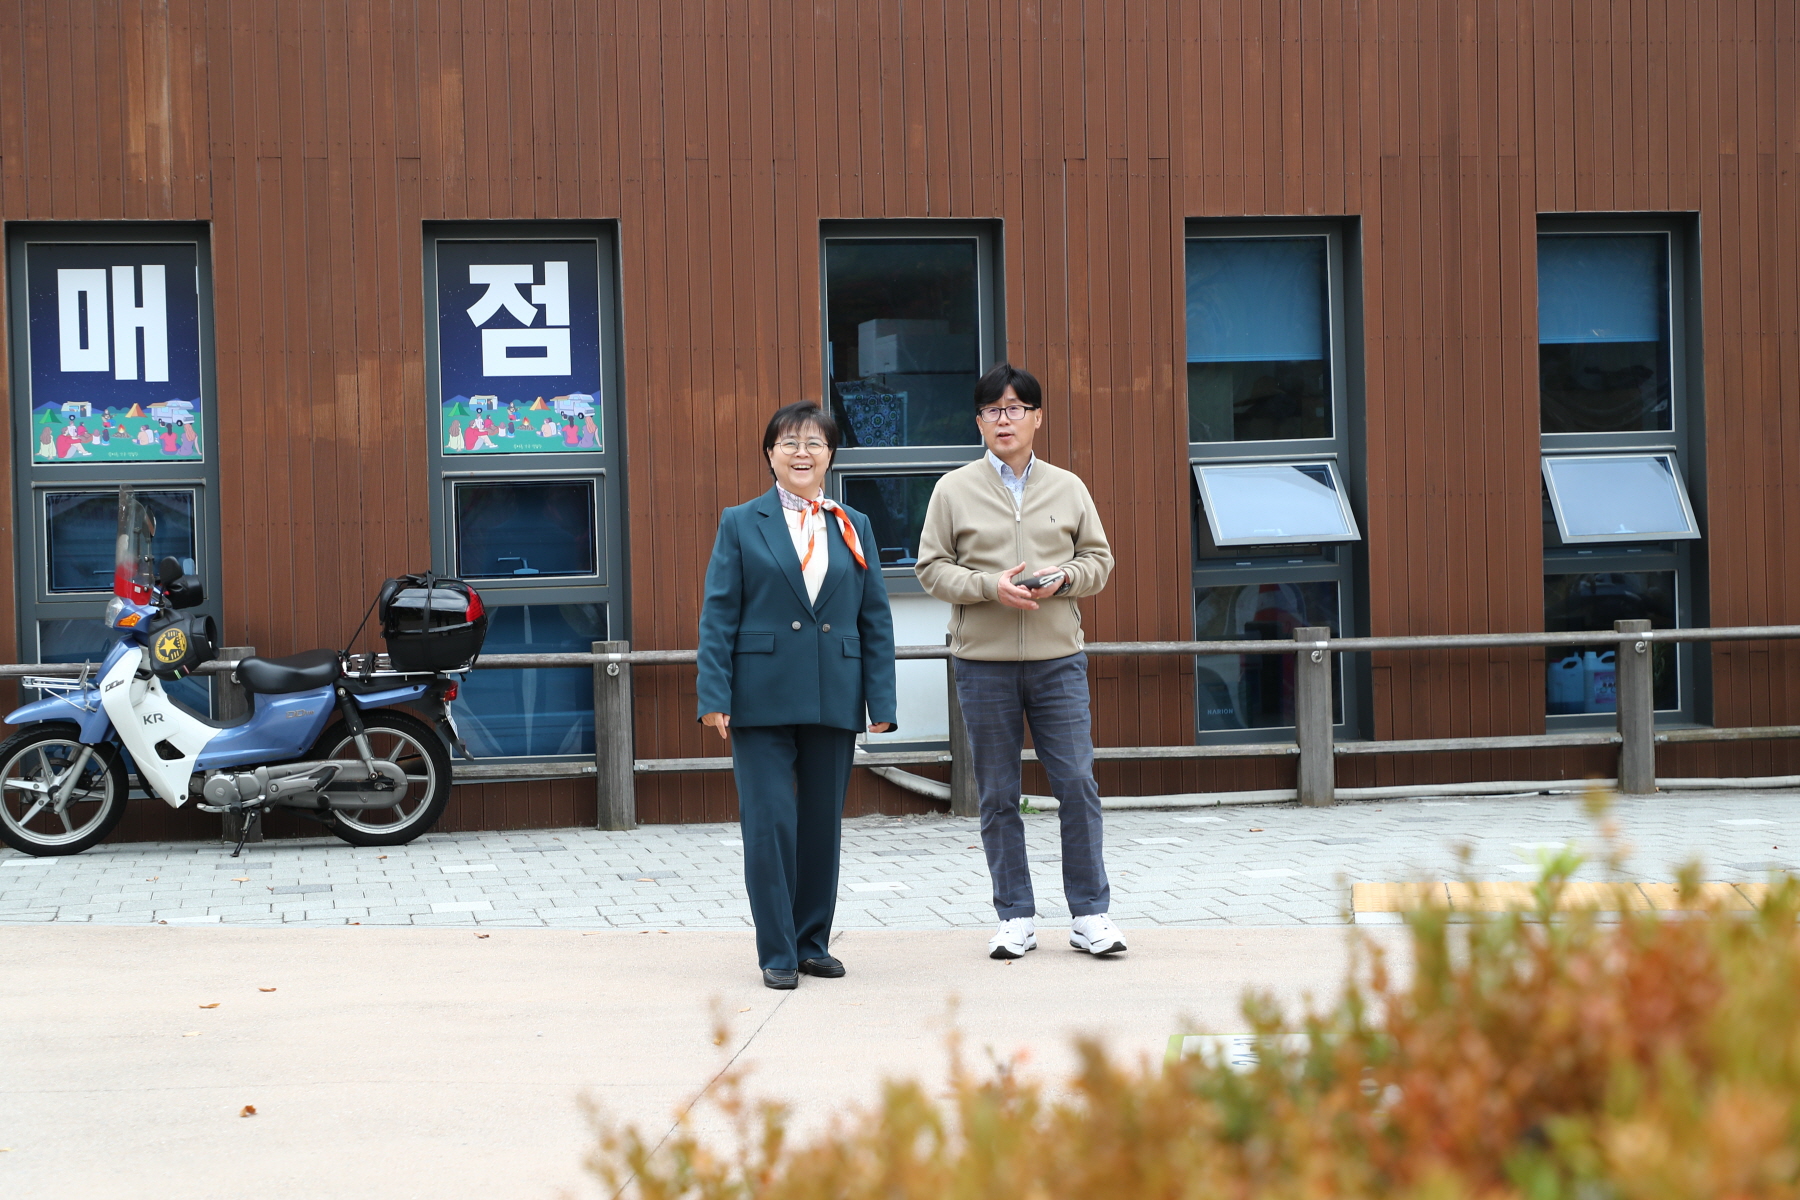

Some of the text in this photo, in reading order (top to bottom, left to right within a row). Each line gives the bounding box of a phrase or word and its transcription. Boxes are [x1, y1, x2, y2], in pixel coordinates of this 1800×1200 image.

[57, 264, 169, 382] 매
[466, 260, 572, 377] 점
[143, 713, 165, 725] KR
